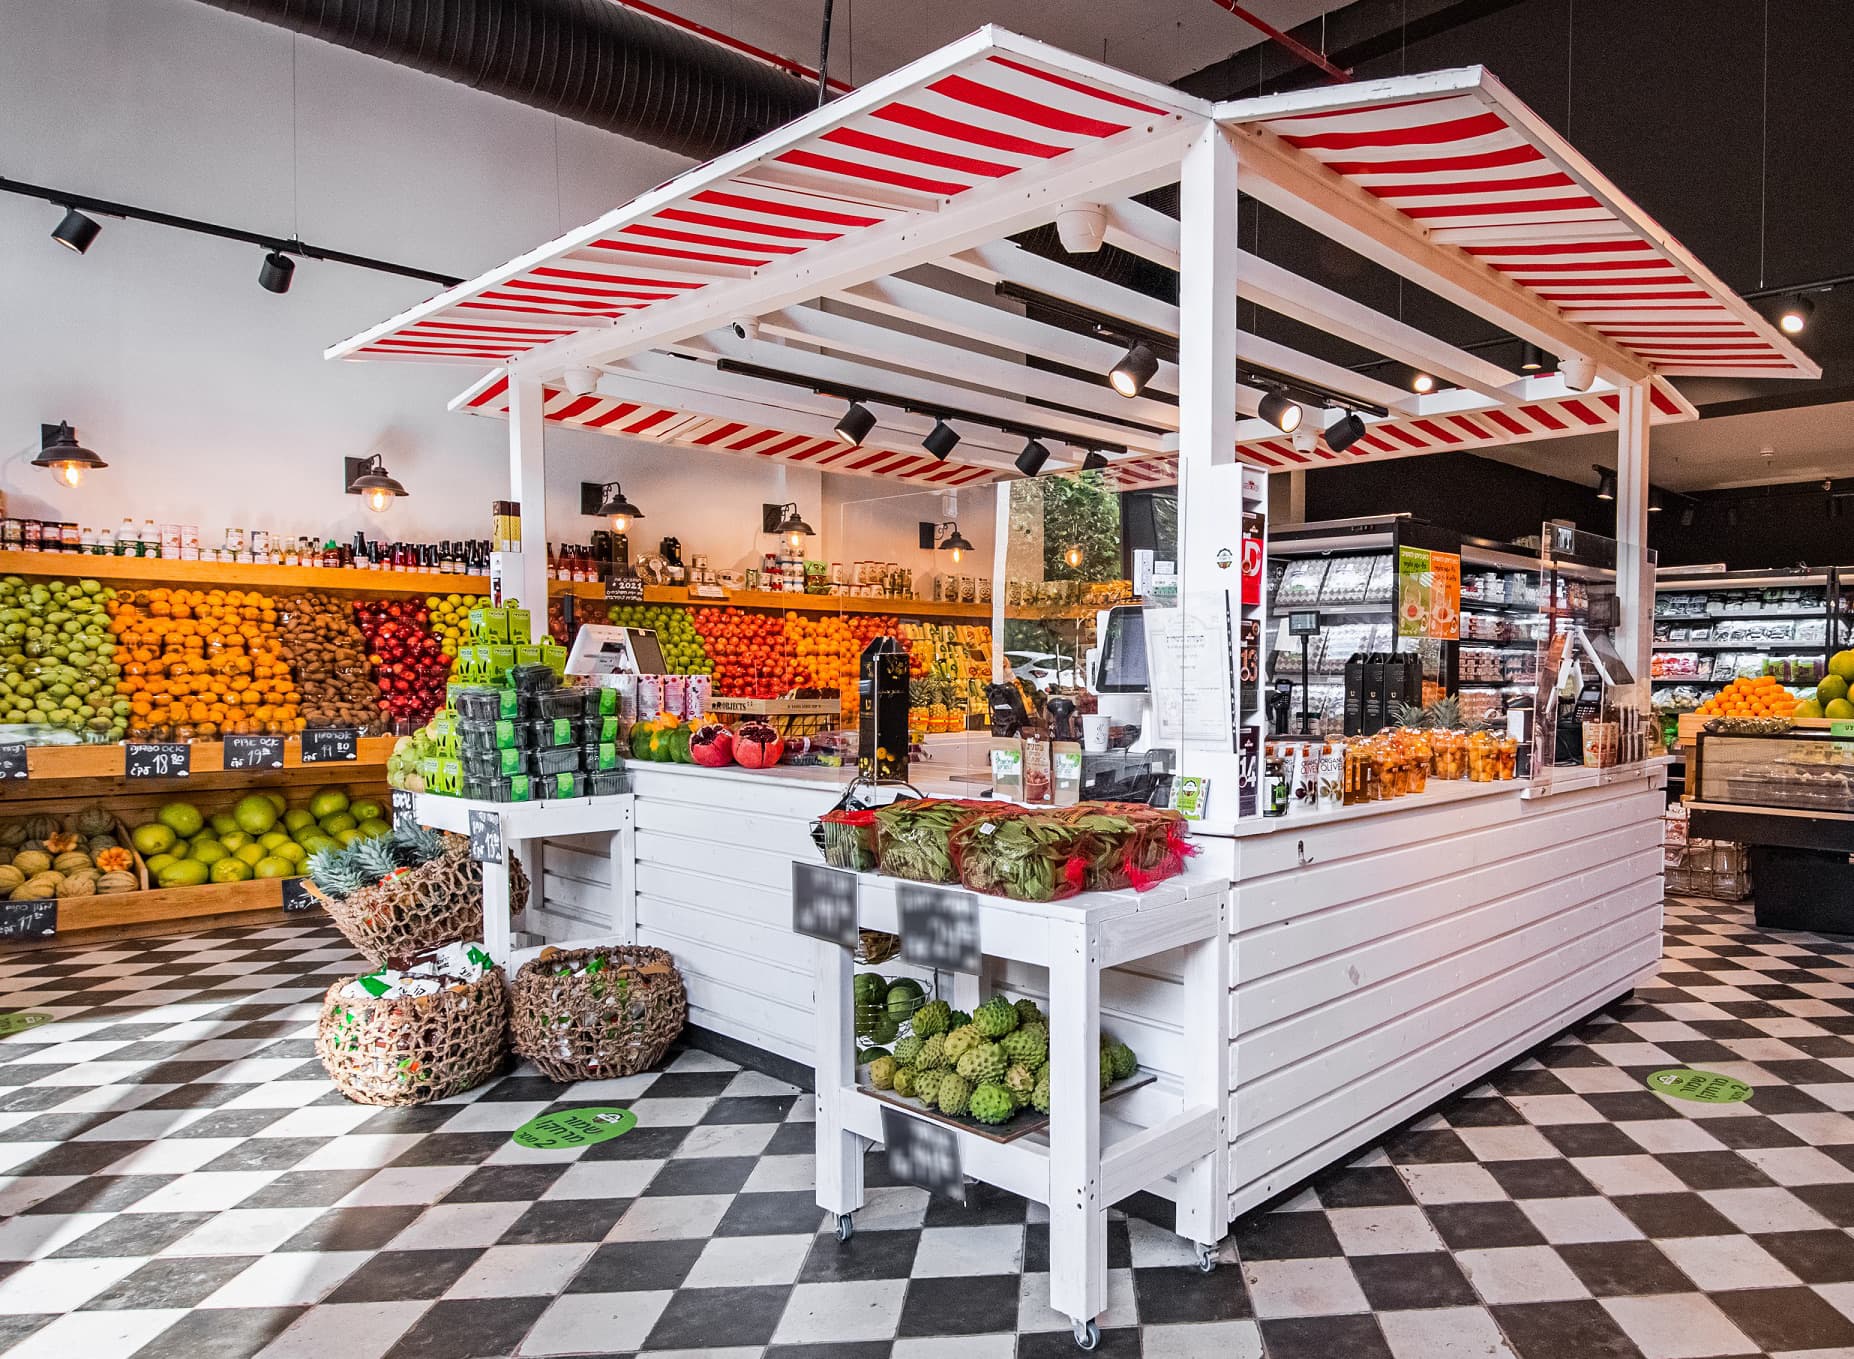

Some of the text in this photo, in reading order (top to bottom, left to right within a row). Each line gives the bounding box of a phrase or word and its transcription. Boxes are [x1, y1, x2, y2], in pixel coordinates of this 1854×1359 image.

[152, 753, 168, 774] 18
[535, 1120, 585, 1143] מרחק
[533, 1139, 557, 1148] 2
